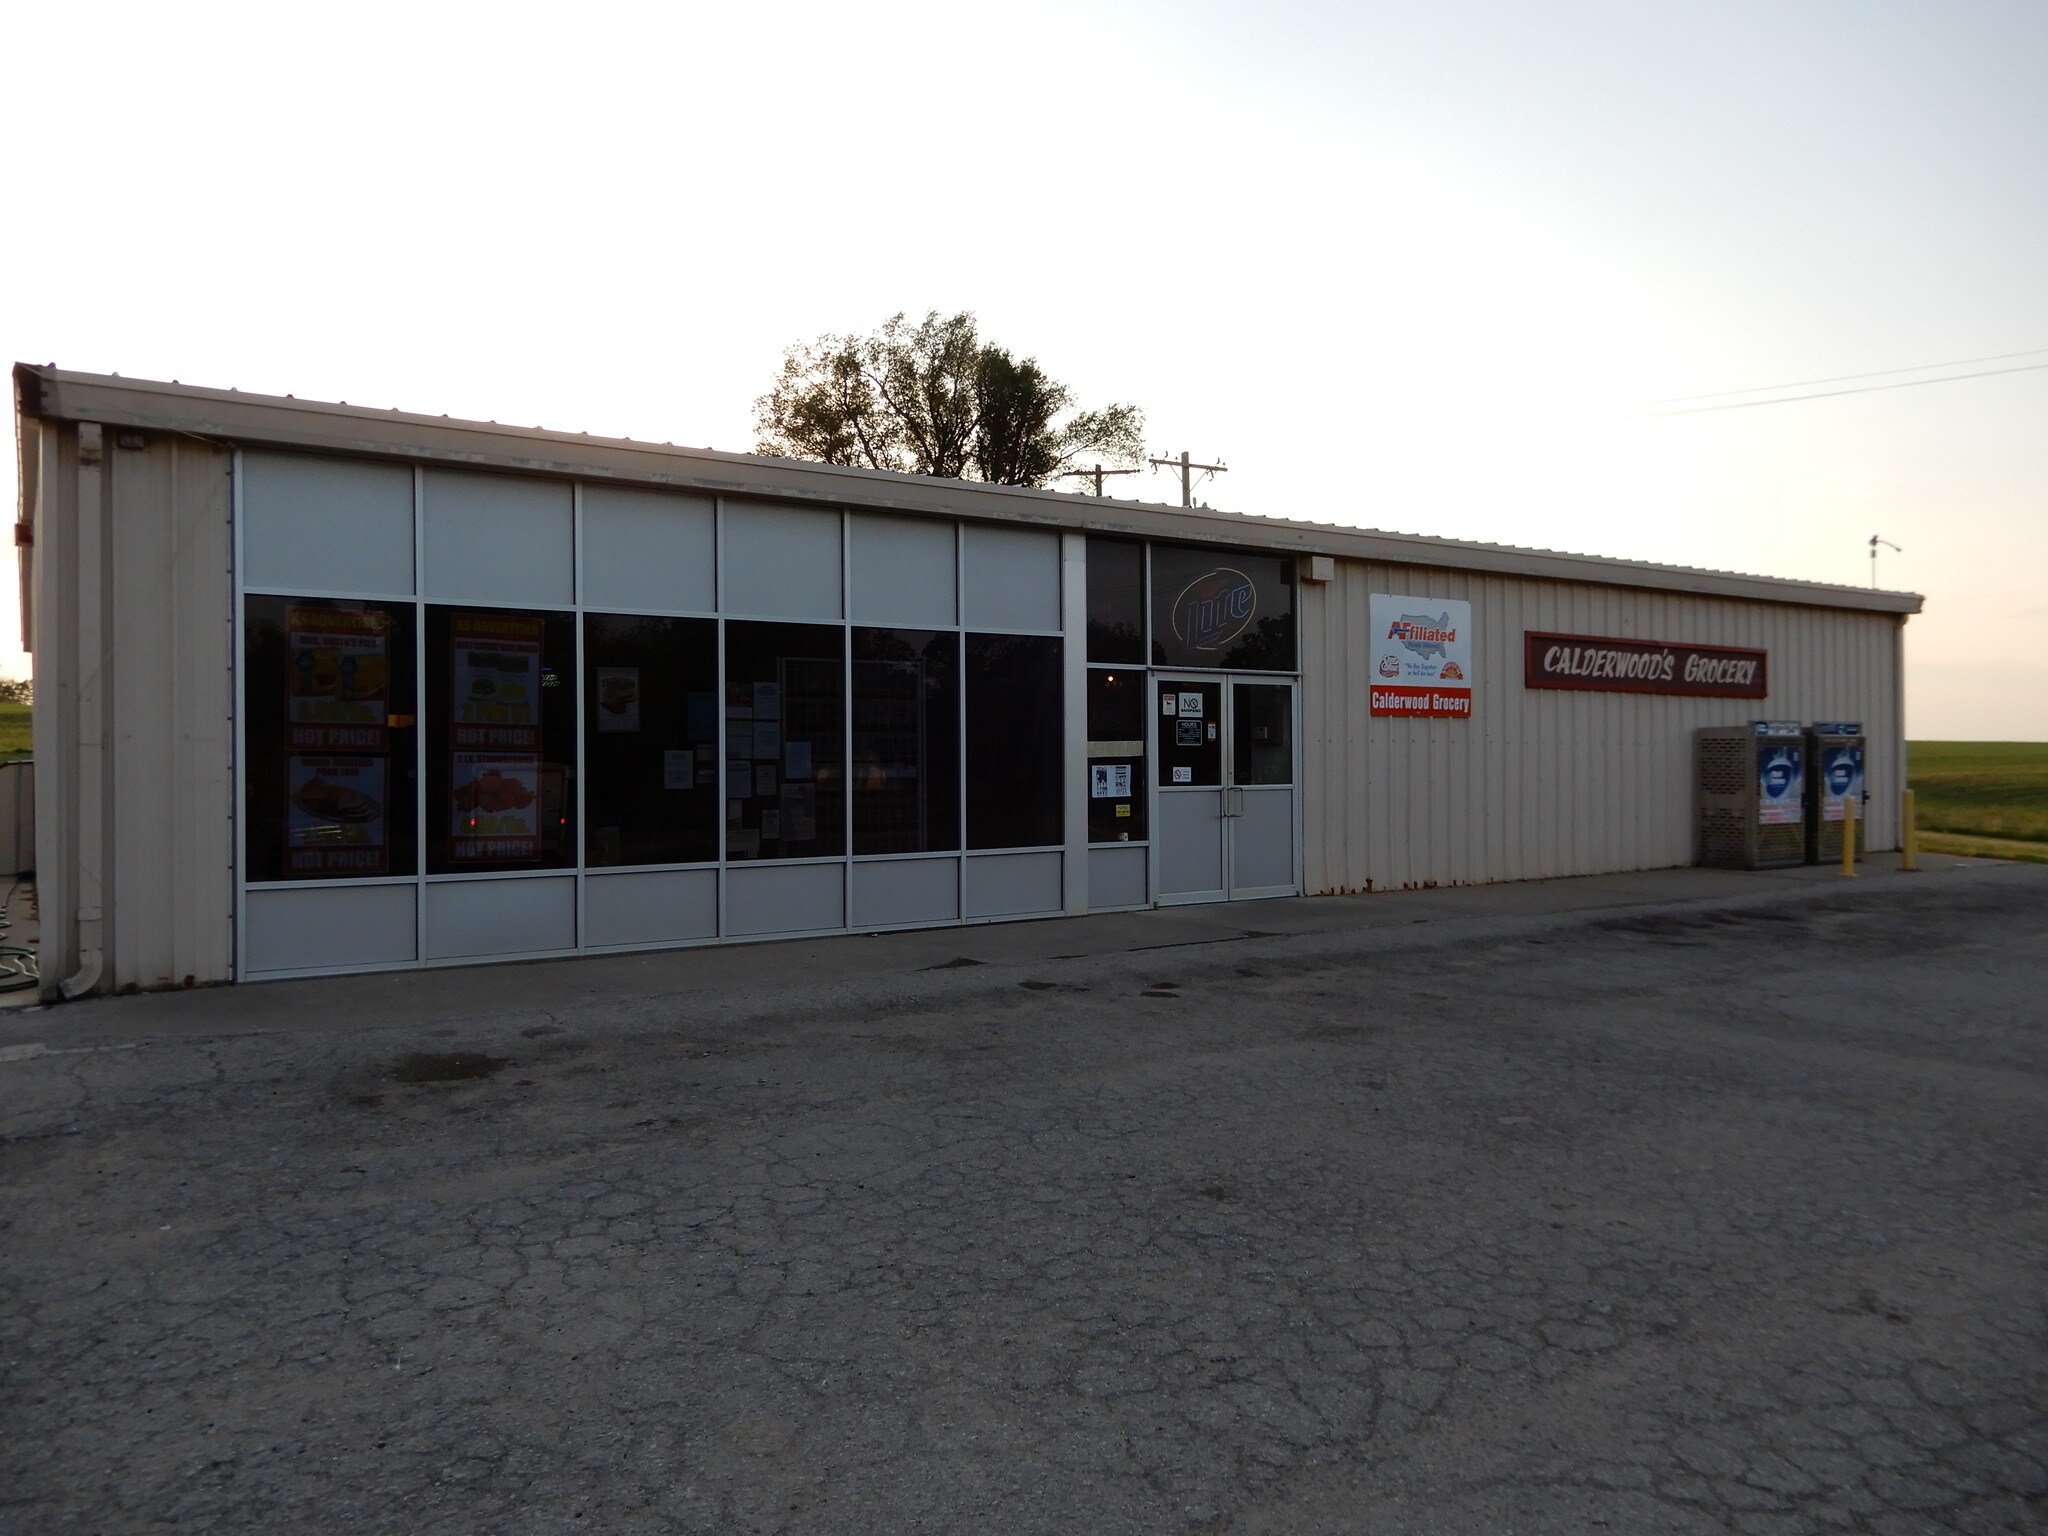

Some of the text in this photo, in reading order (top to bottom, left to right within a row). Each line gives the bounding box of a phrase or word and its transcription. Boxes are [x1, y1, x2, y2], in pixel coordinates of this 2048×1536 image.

[1544, 646, 1757, 685] CALDERWOOD'S GROCERY
[1372, 692, 1470, 713] Calderwood Grocery
[293, 728, 380, 746] HOT PRICE!
[456, 728, 534, 745] HOT PRICE!
[455, 840, 533, 858] HOT PRICE!
[291, 850, 379, 868] HOT PRICE!
